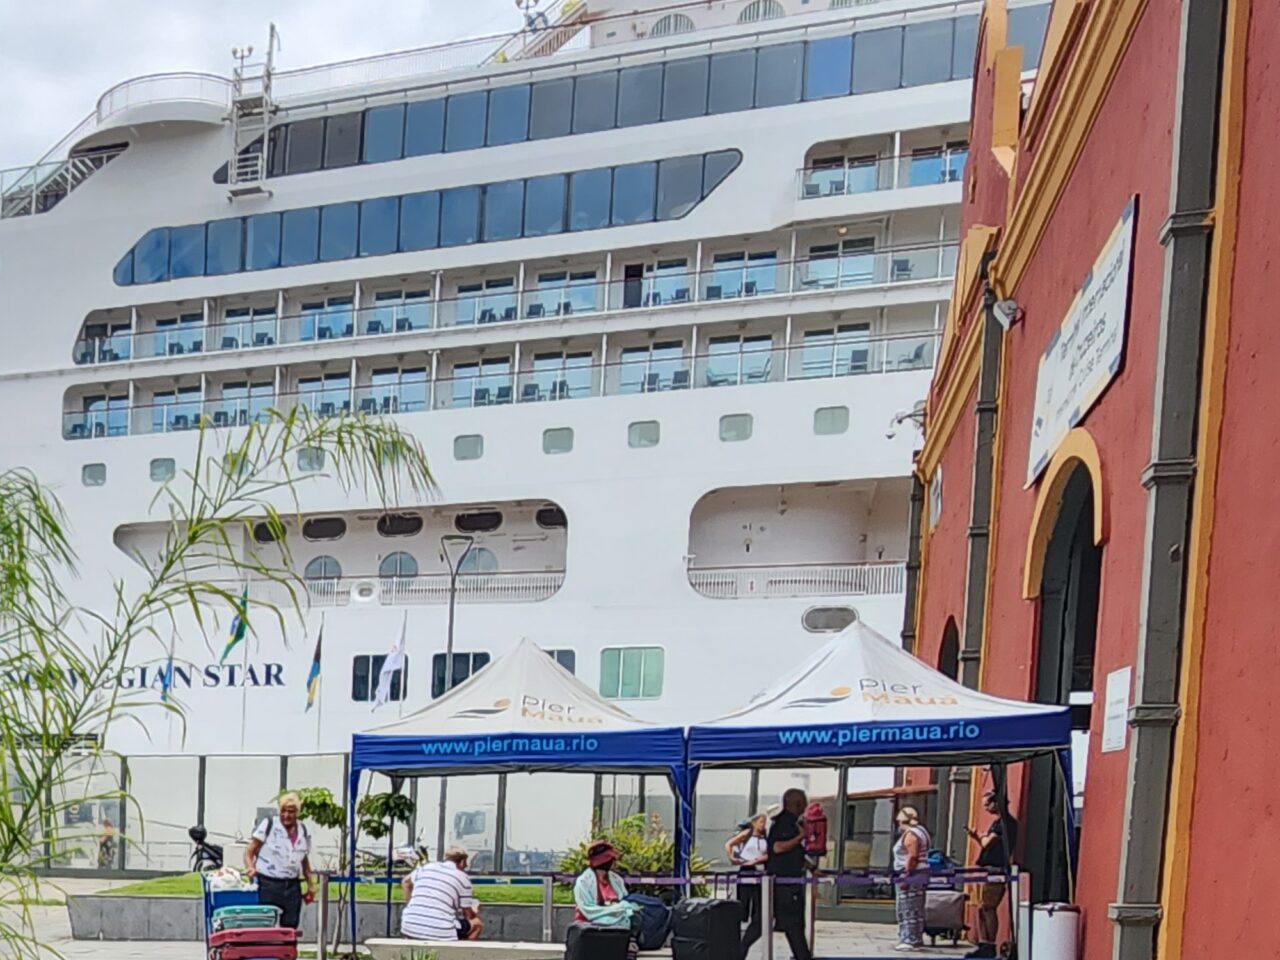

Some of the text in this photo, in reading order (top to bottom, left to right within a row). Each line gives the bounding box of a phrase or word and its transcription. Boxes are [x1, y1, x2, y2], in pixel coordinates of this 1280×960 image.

[202, 662, 286, 688] STAR
[858, 678, 922, 694] Pier
[522, 694, 576, 714] Pier
[422, 734, 599, 757] www.piermaua.rio
[778, 721, 980, 747] www.piermaua.rio
